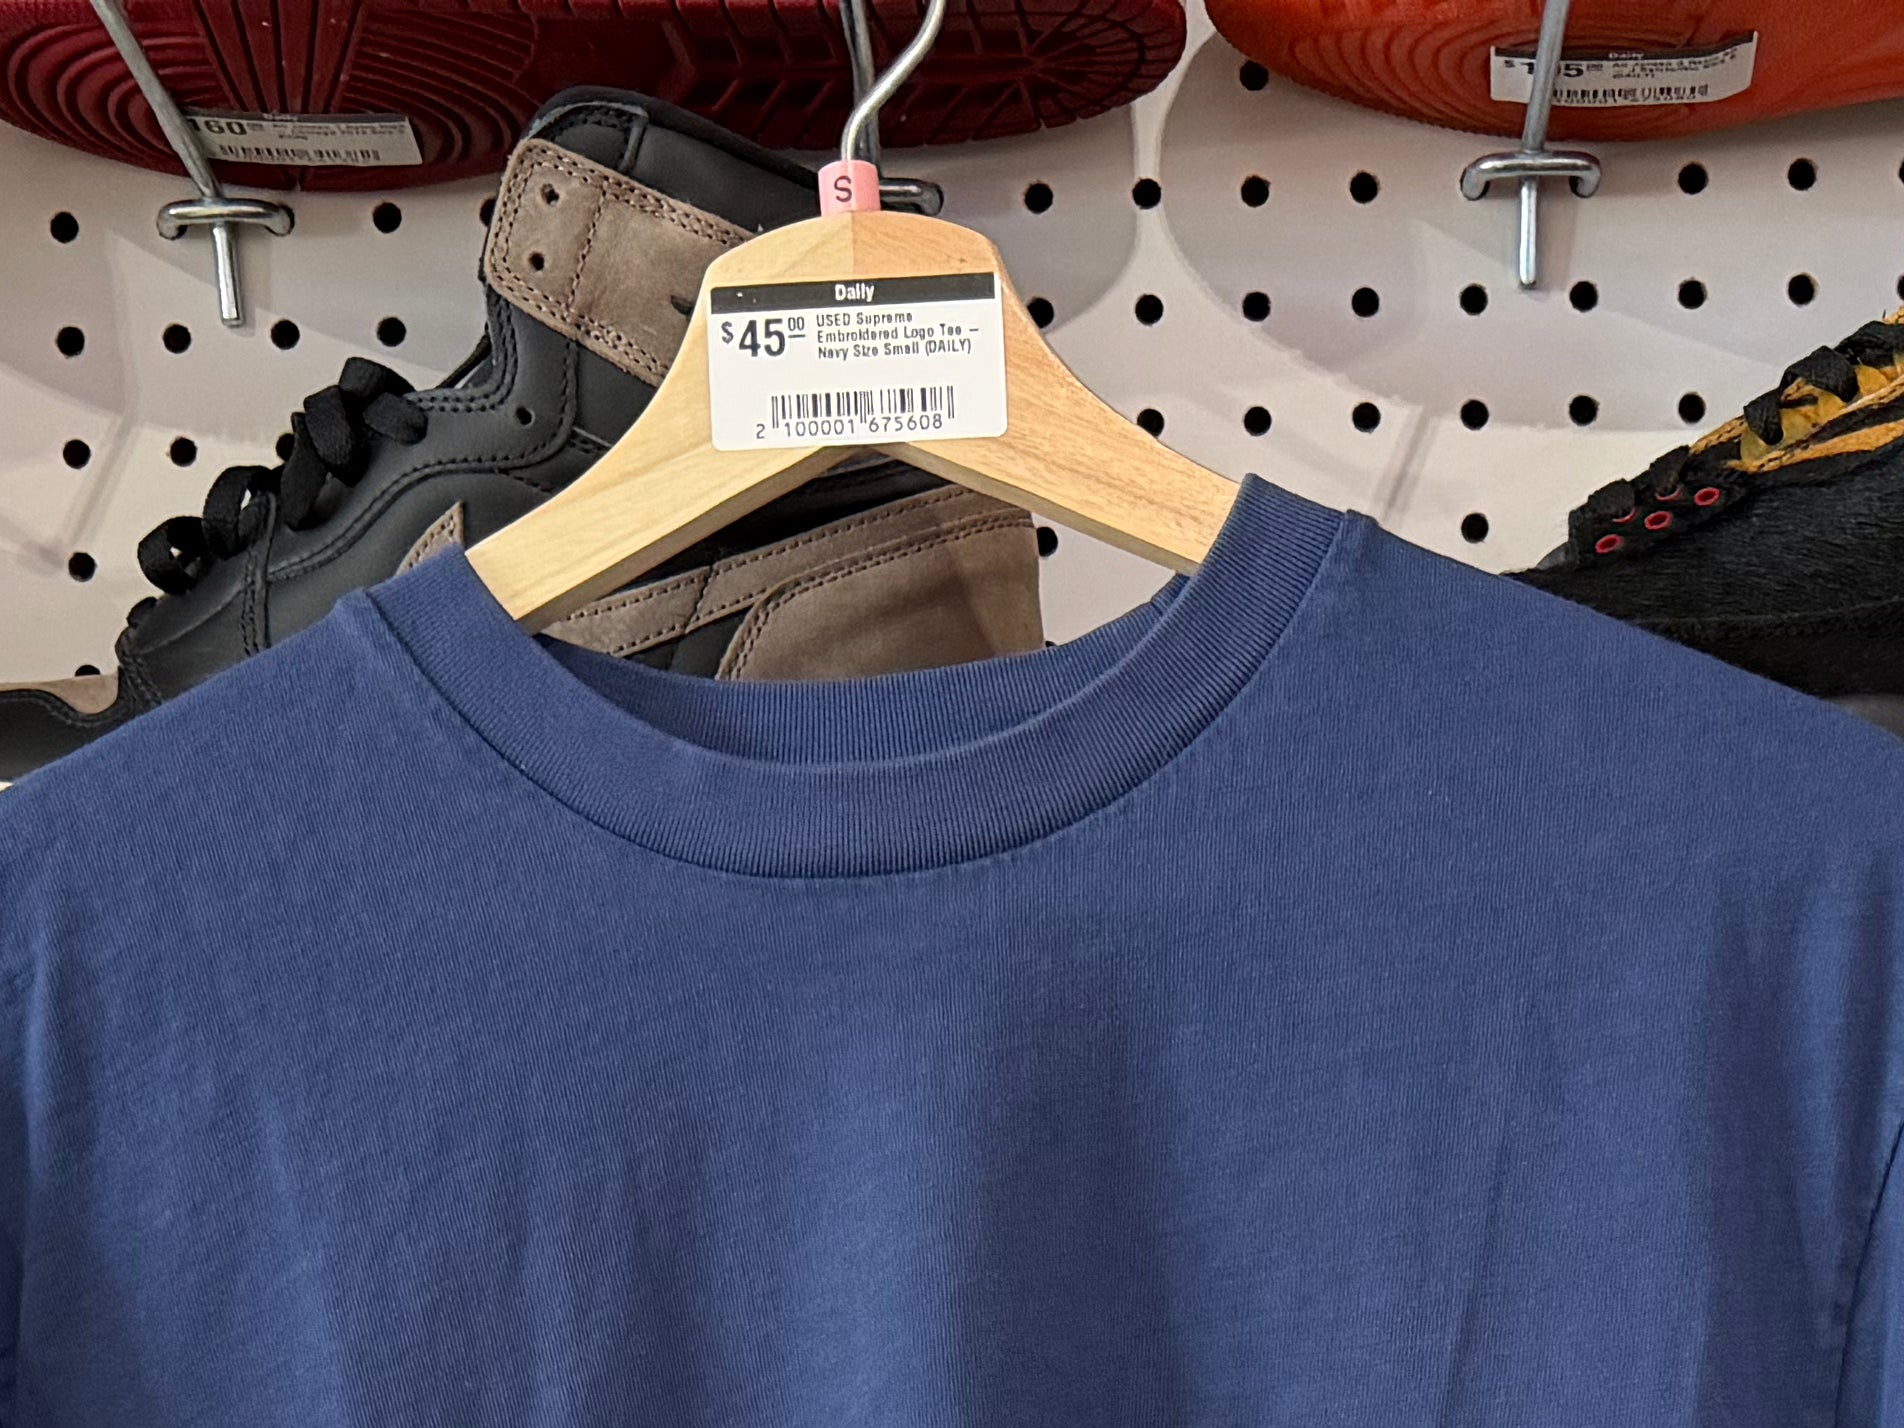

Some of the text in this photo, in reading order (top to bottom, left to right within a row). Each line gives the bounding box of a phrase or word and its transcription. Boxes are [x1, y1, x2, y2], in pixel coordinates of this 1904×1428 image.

[833, 175, 853, 203] S
[834, 283, 875, 303] Daily
[816, 313, 851, 328] USED
[856, 312, 913, 327] Supreme
[904, 326, 934, 341] Logo
[939, 323, 962, 336] Tee
[818, 338, 972, 361] Navy Size Small (DAILY)
[756, 413, 943, 439] 2 100001 675608
